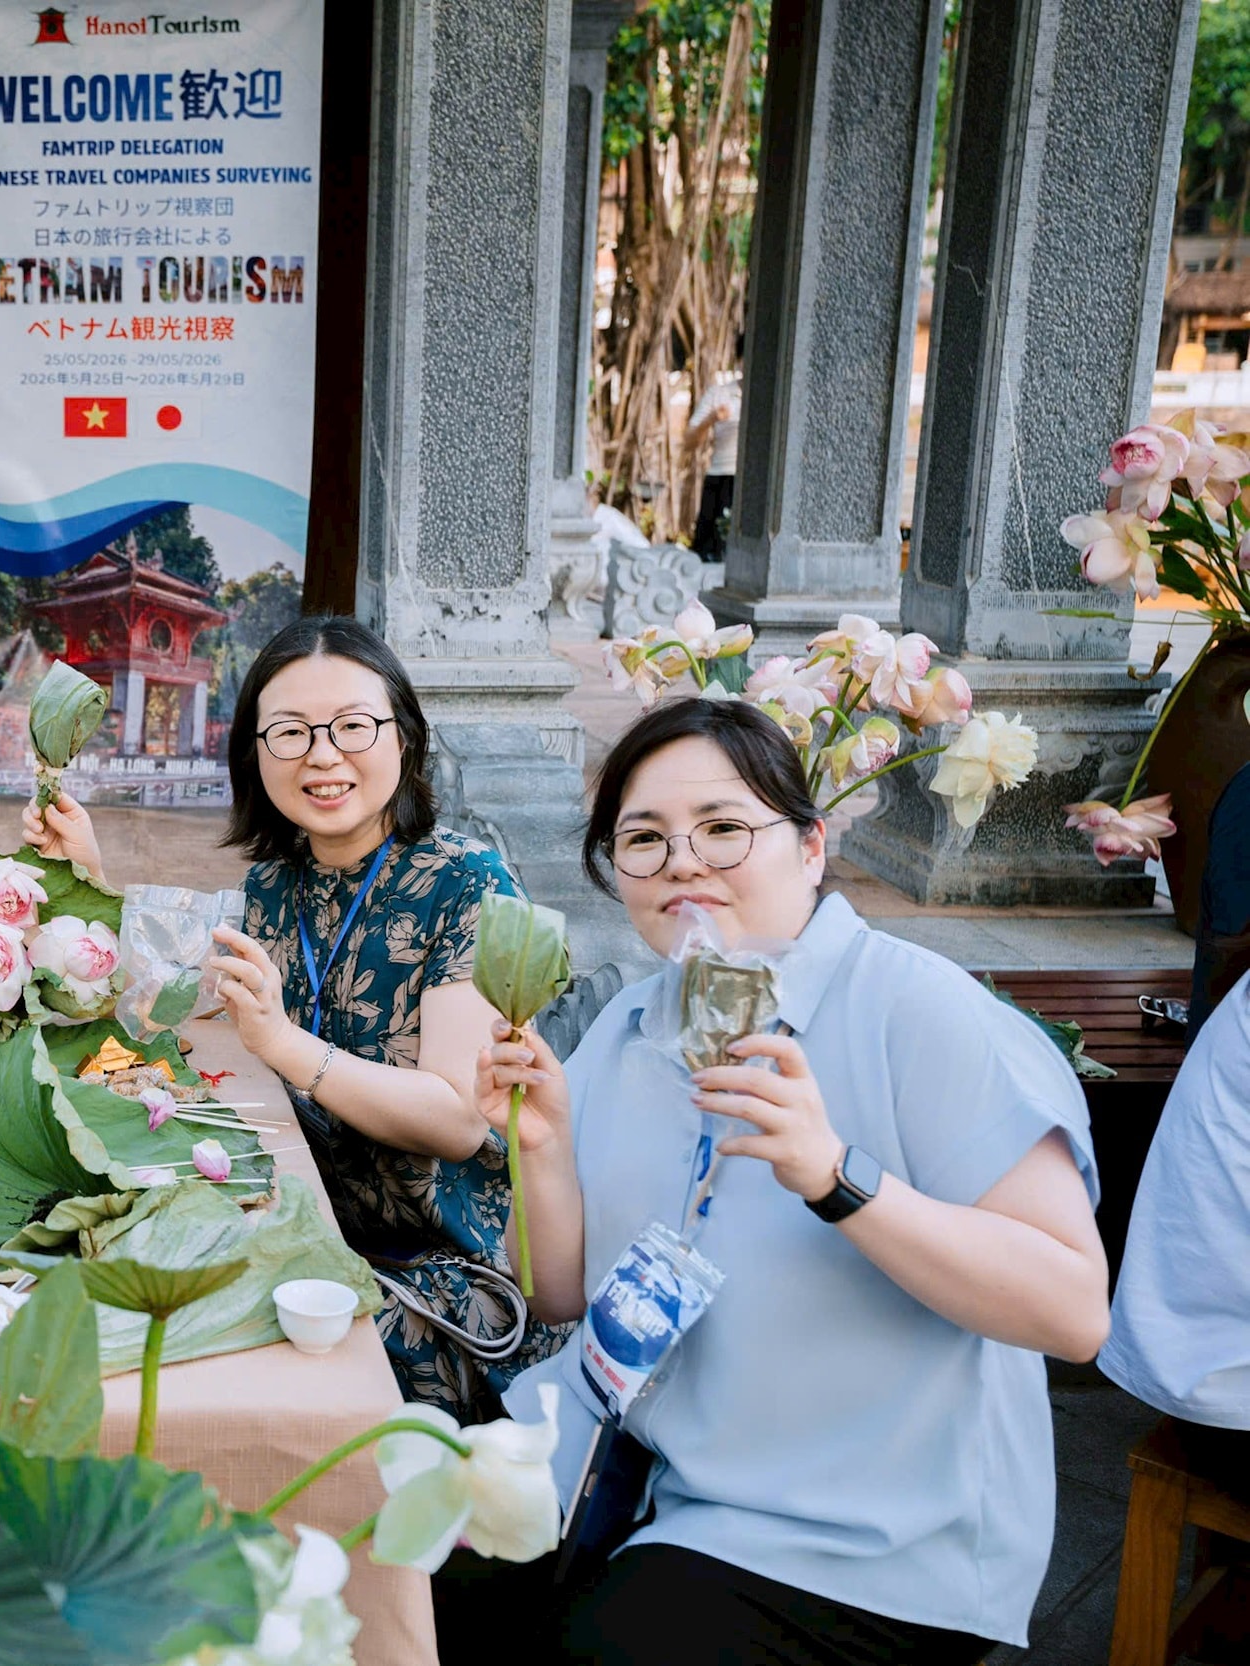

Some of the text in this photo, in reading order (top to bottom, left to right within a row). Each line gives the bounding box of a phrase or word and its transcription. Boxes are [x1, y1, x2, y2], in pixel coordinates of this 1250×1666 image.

[85, 15, 241, 36] HanoiTourism
[180, 68, 282, 121] 歓迎
[42, 138, 224, 157] FAMTRIP DELEGATION
[46, 169, 108, 185] TRAVEL
[113, 168, 210, 184] COMPANIES
[216, 167, 312, 183] SURVEYING
[33, 197, 234, 218] ファムトリップ視察団
[34, 226, 232, 247] 日本の旅行会社による
[136, 256, 305, 304] TOURISM
[27, 316, 236, 342] ベトナム観光視察
[44, 353, 127, 367] 25/05/2026
[127, 757, 156, 774] LONG
[165, 759, 191, 775] NINH
